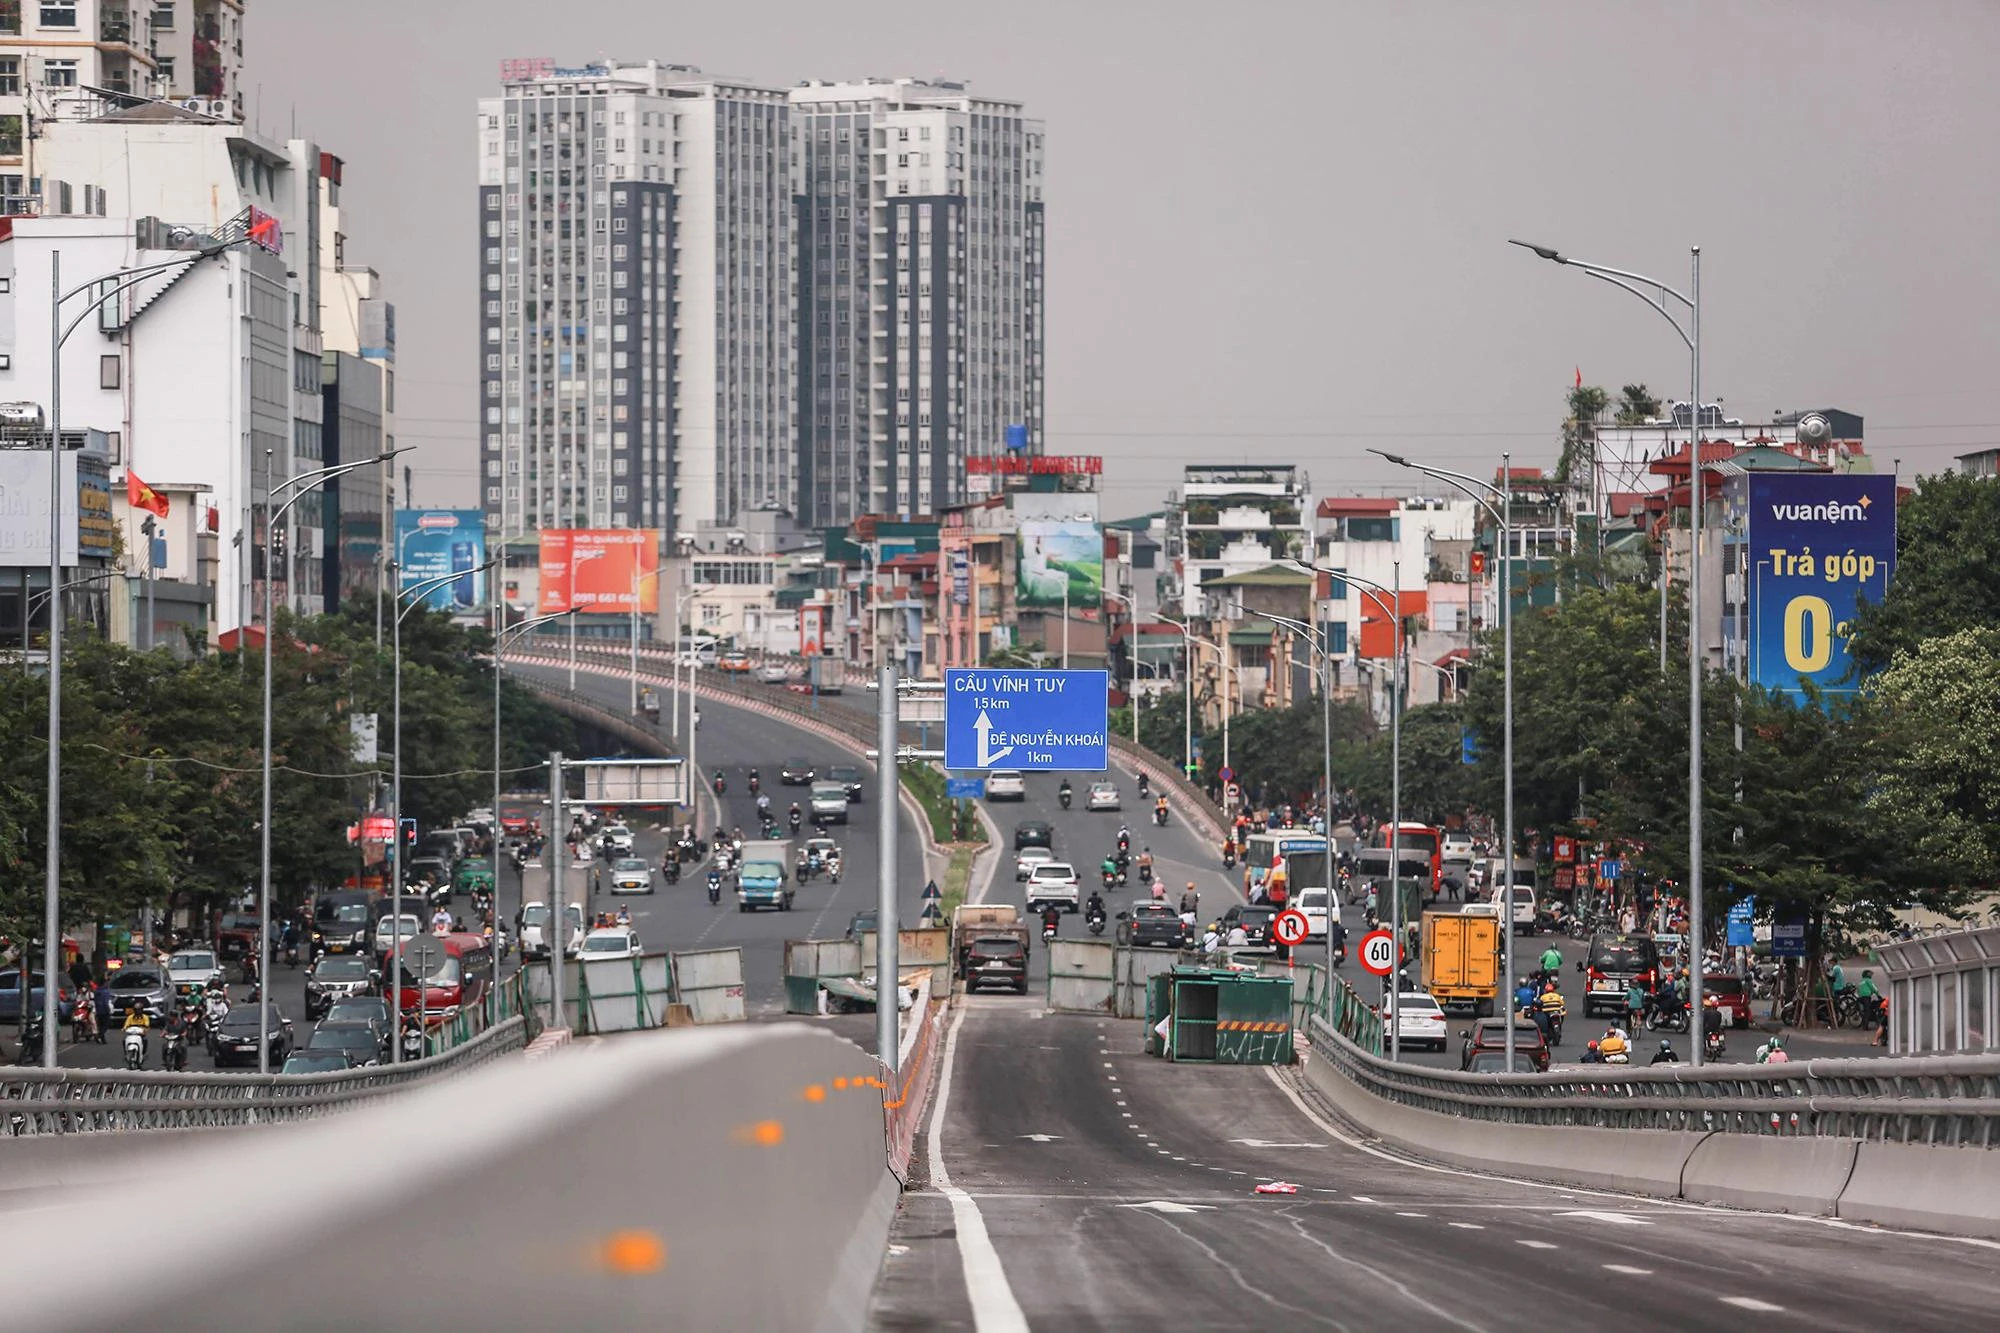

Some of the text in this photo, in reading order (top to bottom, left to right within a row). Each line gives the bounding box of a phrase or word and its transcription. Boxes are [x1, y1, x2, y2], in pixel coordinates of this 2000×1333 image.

[1769, 546, 1875, 583] Trả góp
[954, 672, 1066, 693] CẦU VĨNH TUY
[974, 697, 1010, 710] 1,5 km
[990, 729, 1104, 746] ĐÊ NGUYỄN KHOÁI
[1371, 942, 1389, 961] 60
